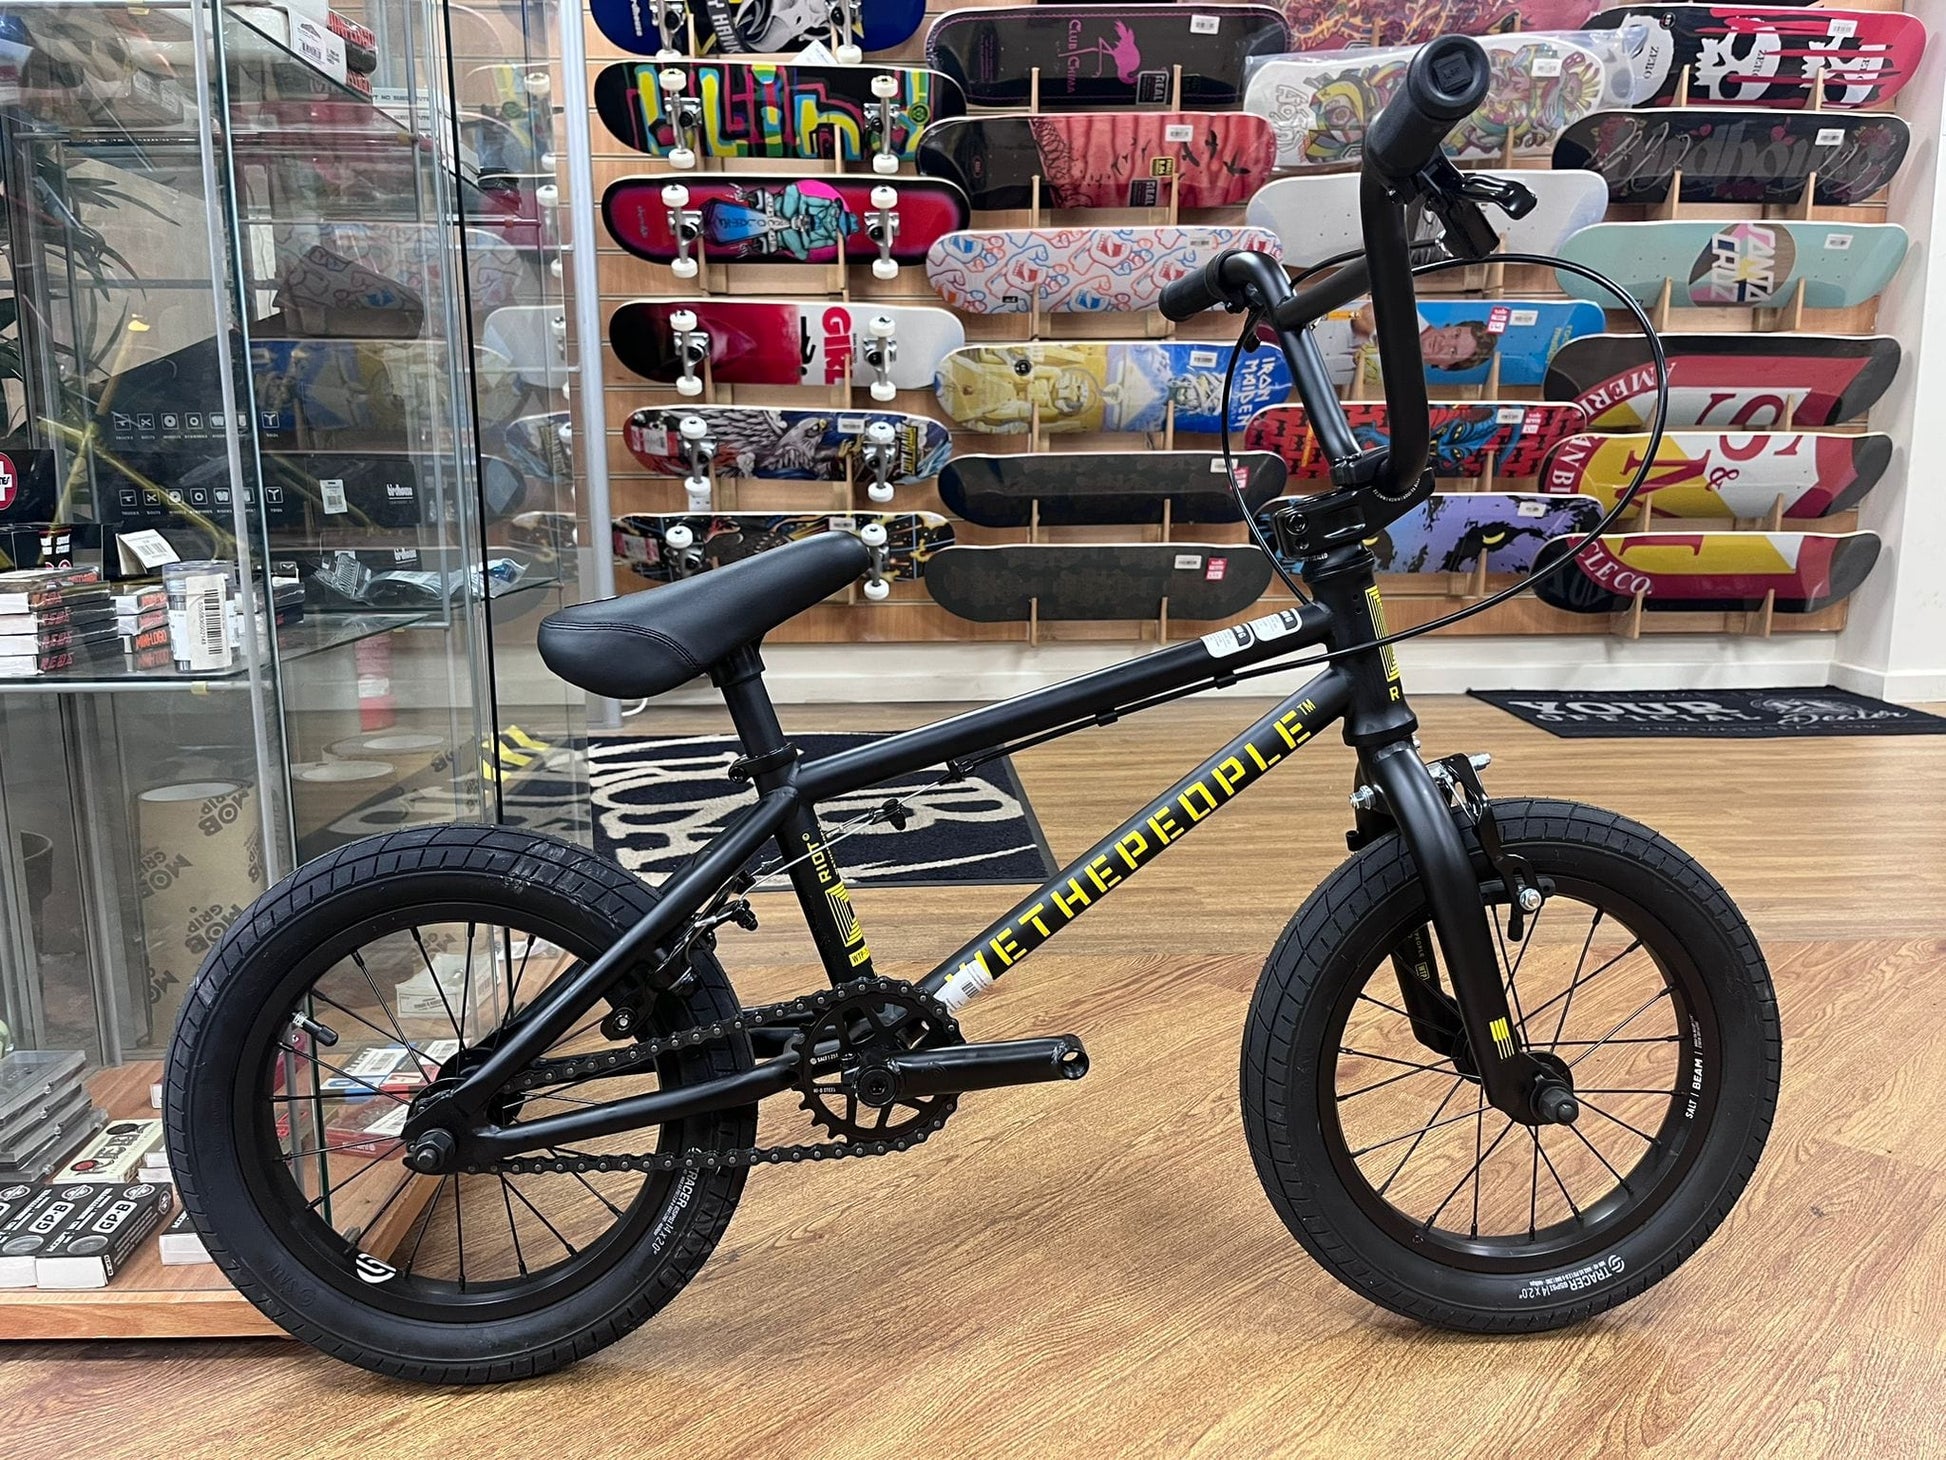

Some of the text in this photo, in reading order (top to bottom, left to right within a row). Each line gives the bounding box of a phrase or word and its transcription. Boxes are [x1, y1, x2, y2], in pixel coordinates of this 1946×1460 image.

[713, 13, 743, 54] HAWK
[1066, 19, 1082, 93] CLUB CHIMA
[1645, 46, 1659, 79] ZERO
[1153, 74, 1167, 102] REAL
[1145, 181, 1156, 206] REAL
[1711, 233, 1739, 303] CRUZ
[1746, 223, 1777, 303] SANTA
[822, 306, 853, 386] GIRL
[1235, 359, 1260, 426] MAIDEN
[1254, 356, 1276, 402] IRON
[1388, 685, 1400, 702] R
[1508, 700, 1740, 715] YOUR
[1537, 713, 1762, 722] OFFICIAL
[198, 790, 250, 837] MOB
[188, 904, 223, 934] GRIP
[1685, 1099, 1697, 1119] SALT
[1692, 1058, 1703, 1091] BEAM
[676, 1166, 701, 1209] TRACER
[1569, 1266, 1612, 1291] TRACER
